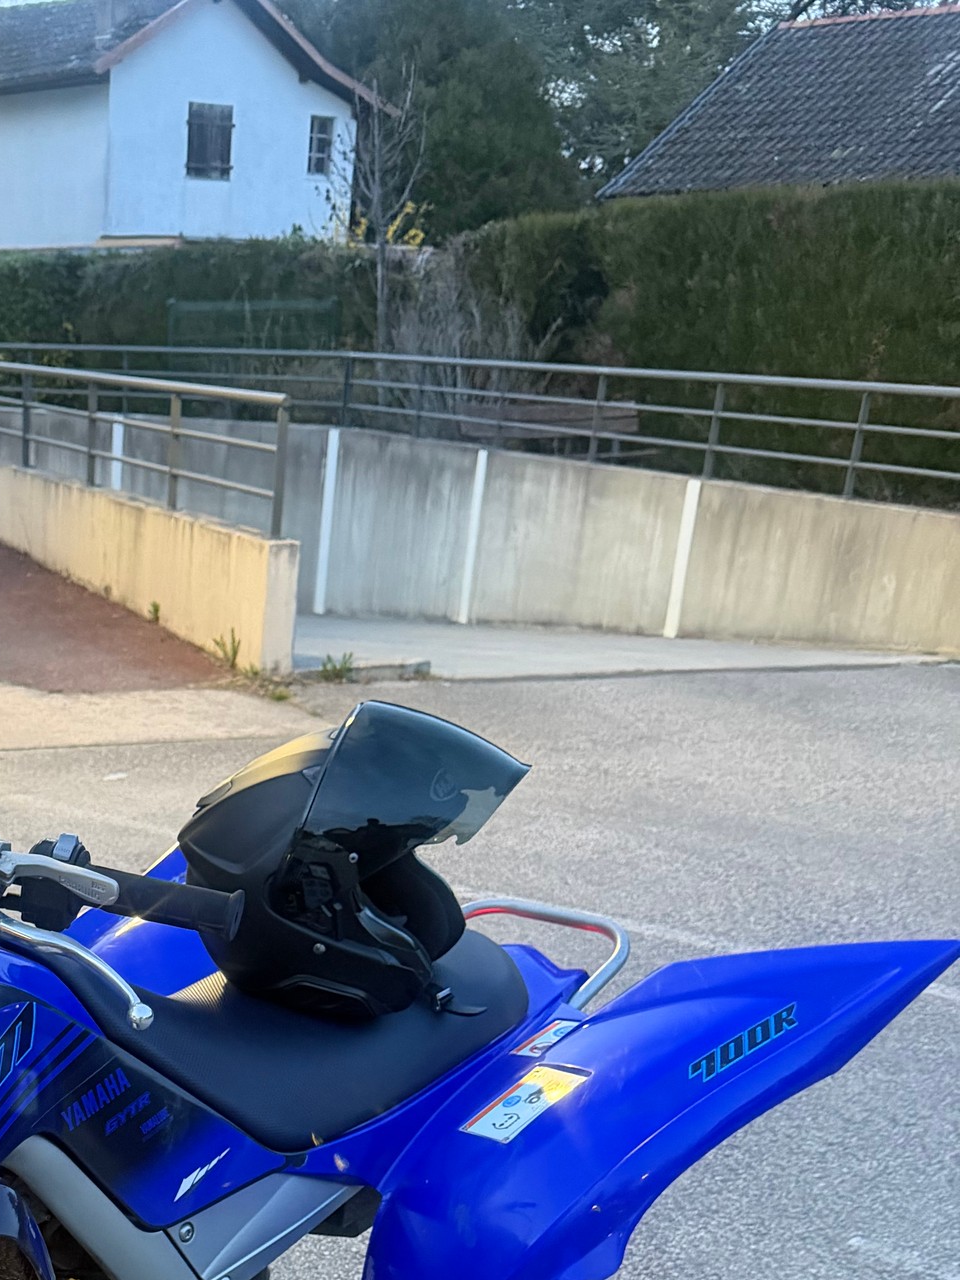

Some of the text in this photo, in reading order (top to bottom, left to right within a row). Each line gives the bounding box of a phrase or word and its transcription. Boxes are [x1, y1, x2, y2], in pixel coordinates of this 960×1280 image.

[688, 1001, 799, 1083] 700R
[60, 1067, 132, 1132] YAMAHA
[104, 1091, 151, 1136] GYTR
